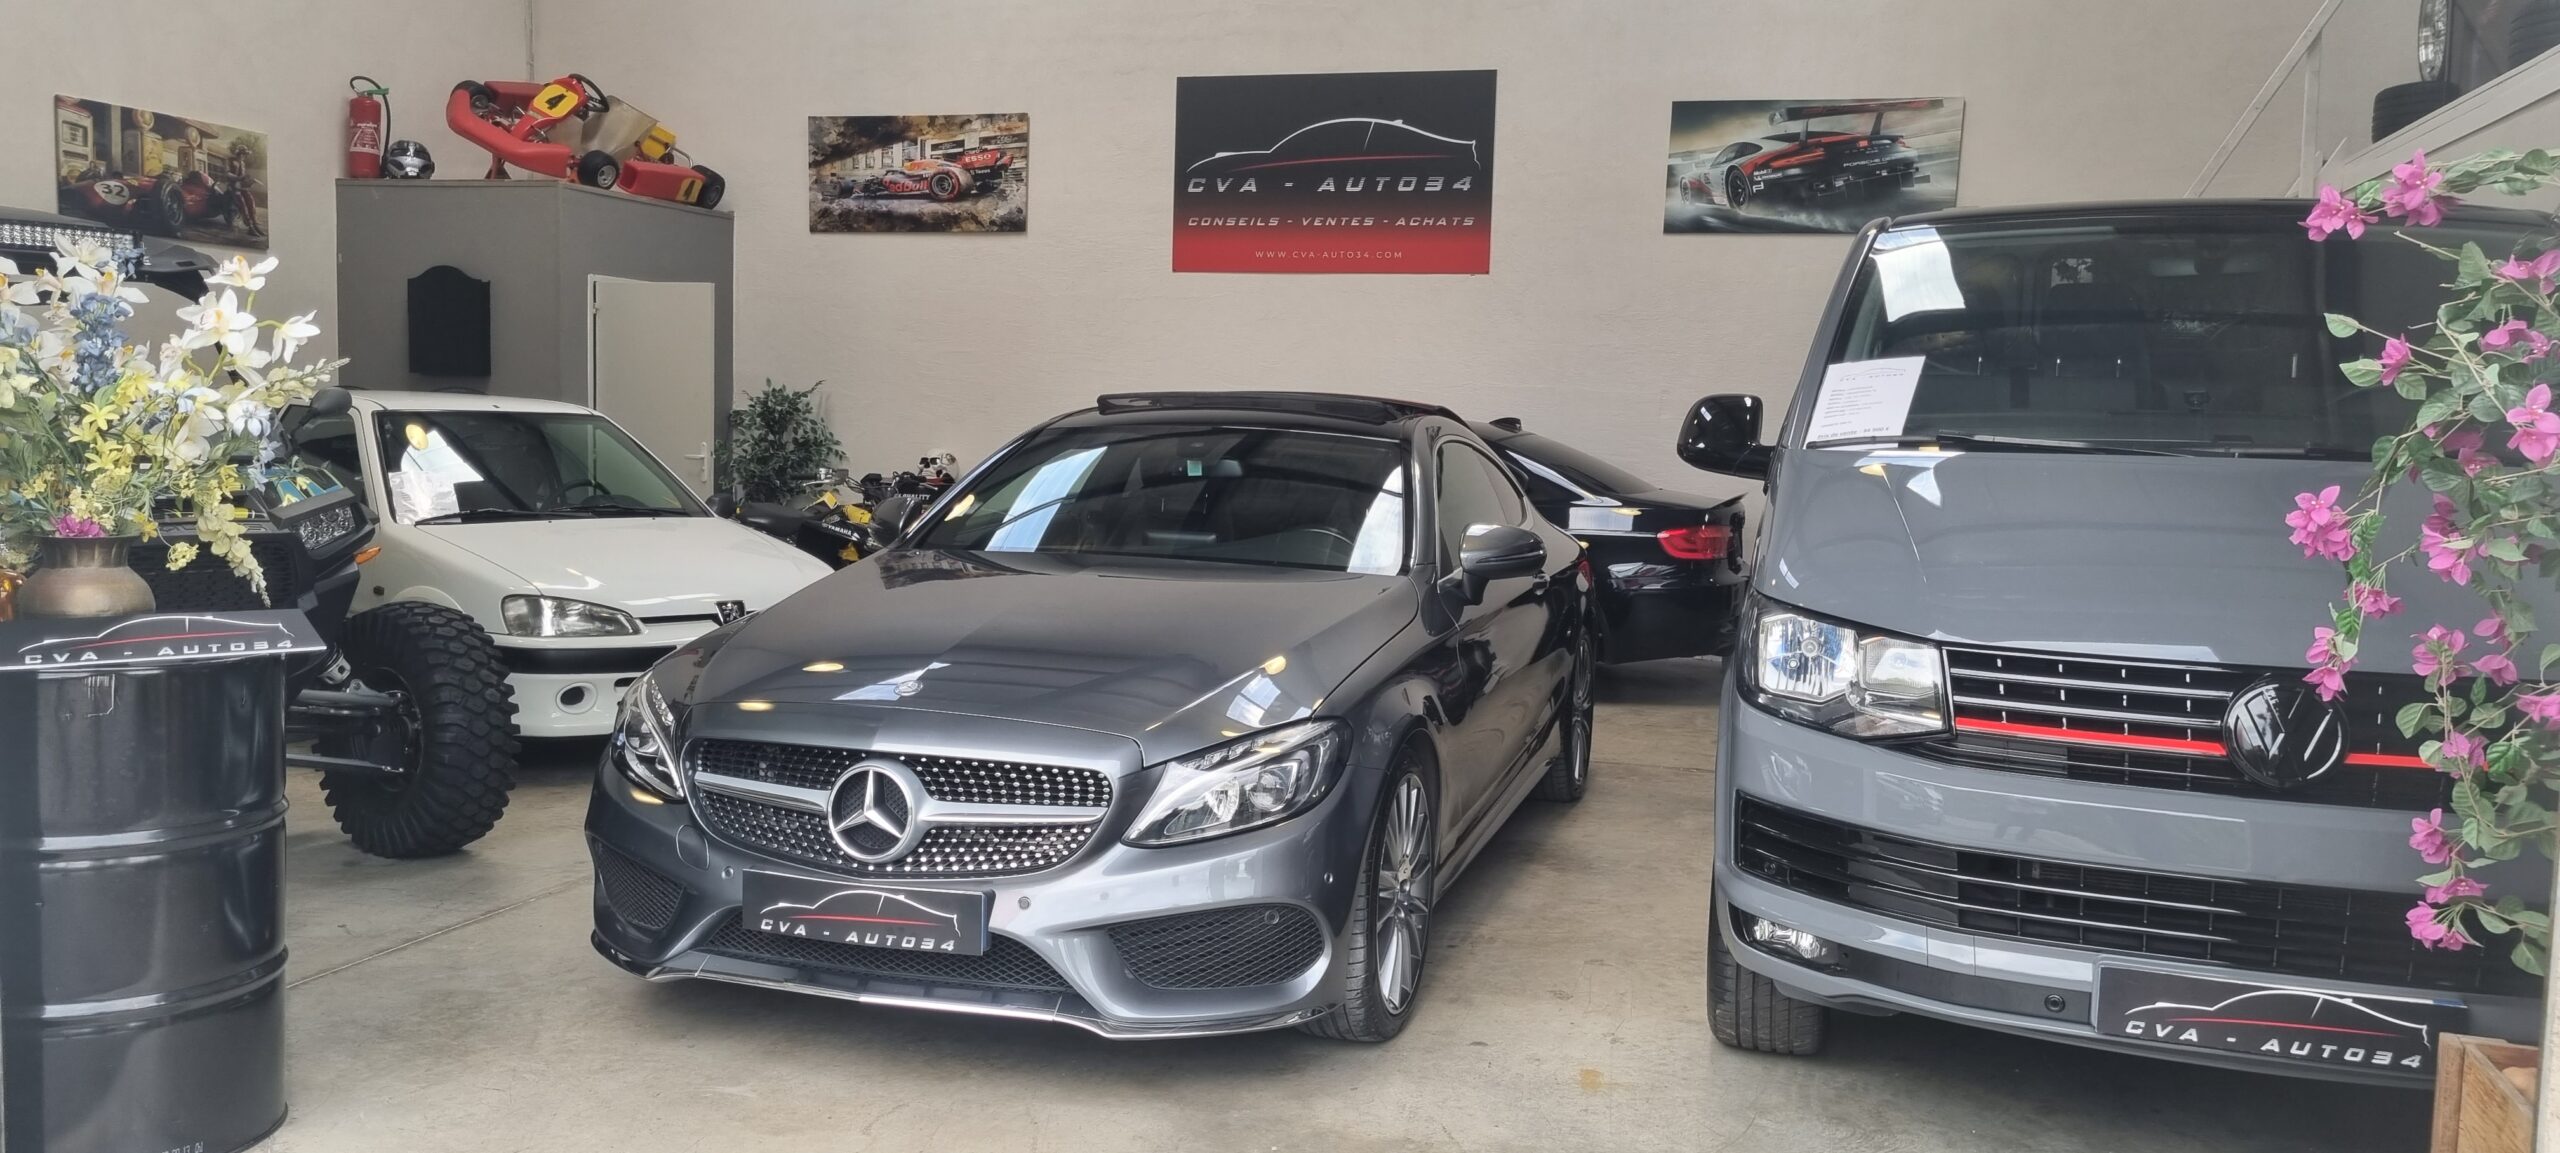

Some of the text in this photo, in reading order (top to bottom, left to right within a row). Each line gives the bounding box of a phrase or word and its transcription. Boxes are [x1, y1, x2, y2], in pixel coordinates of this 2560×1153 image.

[545, 93, 567, 110] 4
[965, 153, 992, 162] ESSO
[101, 183, 126, 198] 32
[1187, 177, 1257, 193] CVA
[1316, 176, 1472, 192] AUTO34
[1188, 217, 1280, 226] CONSEILS
[1302, 217, 1375, 226] VENTES
[1395, 217, 1475, 226] ACHATS
[1255, 250, 1403, 259] WWW.CVA-AUTO34.COM
[829, 525, 852, 536] YAMAHA
[25, 652, 98, 665] CVA
[158, 640, 294, 656] AUTO34
[760, 918, 807, 936] CVA
[846, 930, 955, 951] AUTO34
[2125, 1020, 2198, 1042] CVA
[2260, 1038, 2422, 1068] AUTO34
